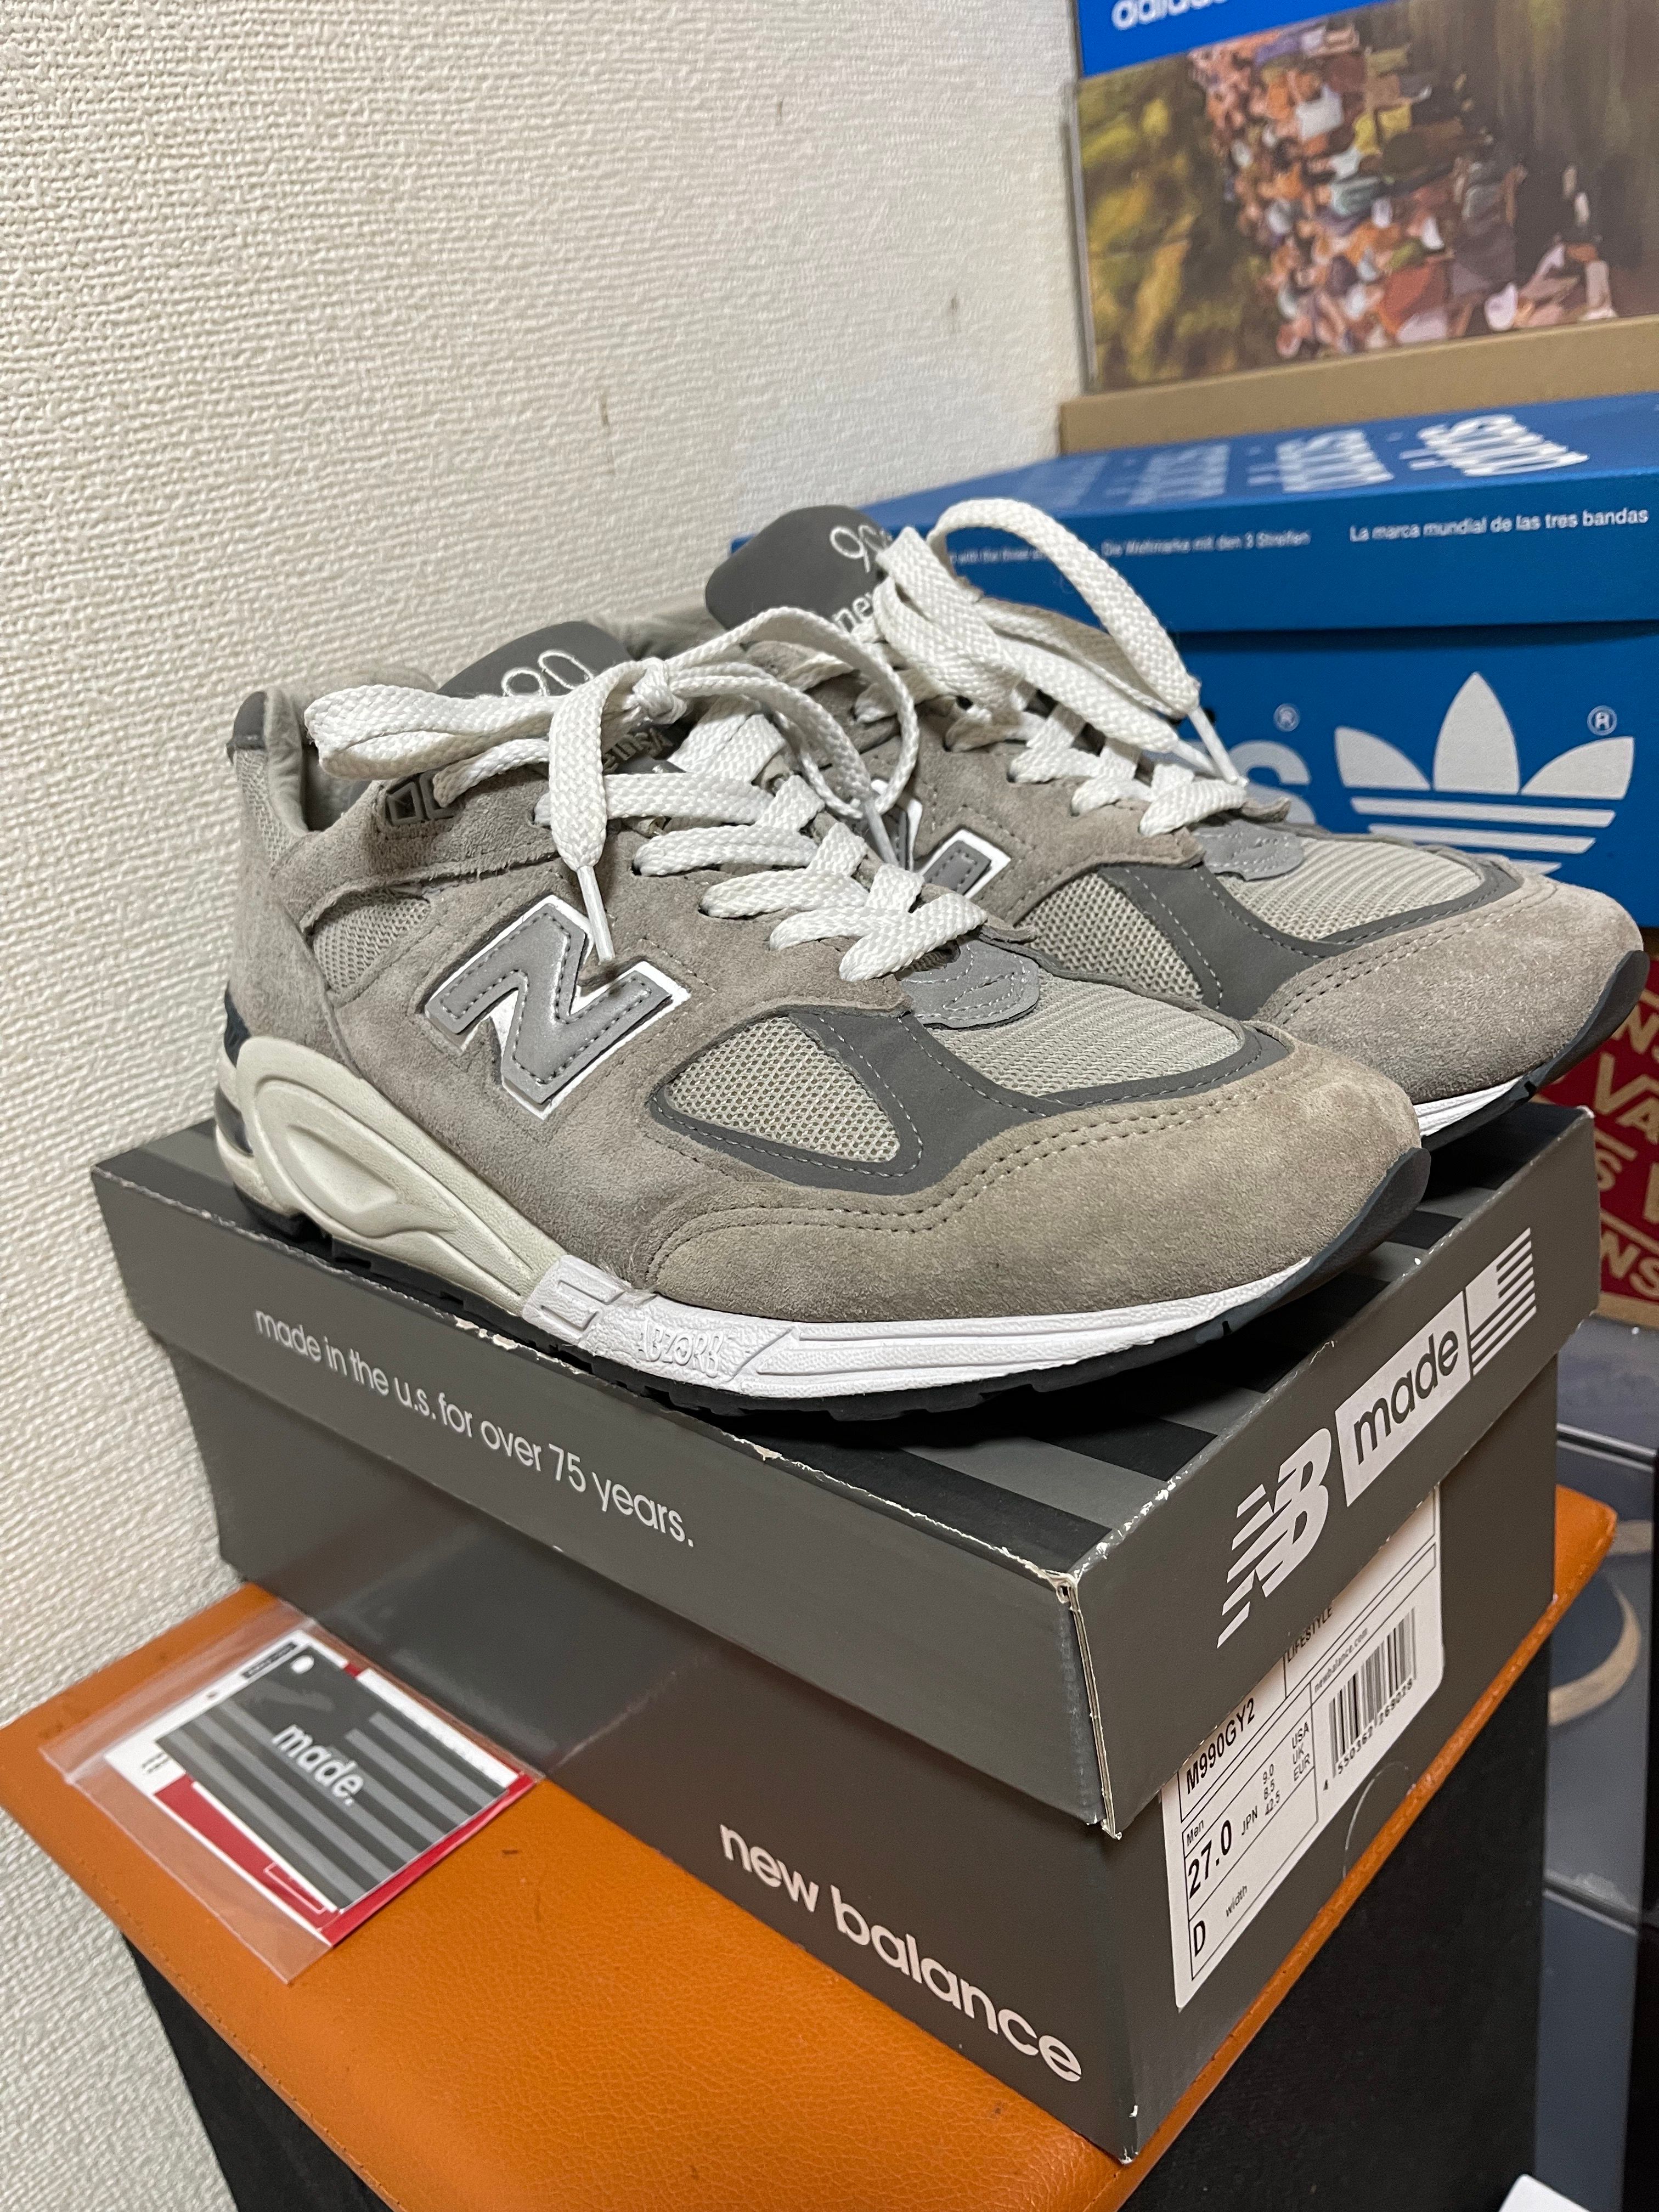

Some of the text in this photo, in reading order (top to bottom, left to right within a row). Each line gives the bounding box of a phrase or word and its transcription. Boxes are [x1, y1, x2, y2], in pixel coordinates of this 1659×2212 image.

[1350, 507, 1649, 542] La marca mundial de las tres bandas
[256, 1310, 695, 1548] made in the u.s. for over 75 years.
[1352, 1330, 1460, 1466] made
[272, 1724, 364, 1807] made.
[1186, 1697, 1255, 1795] M990GY2
[1262, 1722, 1310, 1785] 9.0 USA
[1263, 1742, 1304, 1800] 8.5 UK
[1265, 1753, 1311, 1815] 42.5 EUR
[1186, 1820, 1204, 1847] Men
[1187, 1805, 1258, 1900] 27.0 JPN
[719, 1824, 1082, 2082] new balance
[1193, 1885, 1248, 1957] D width
